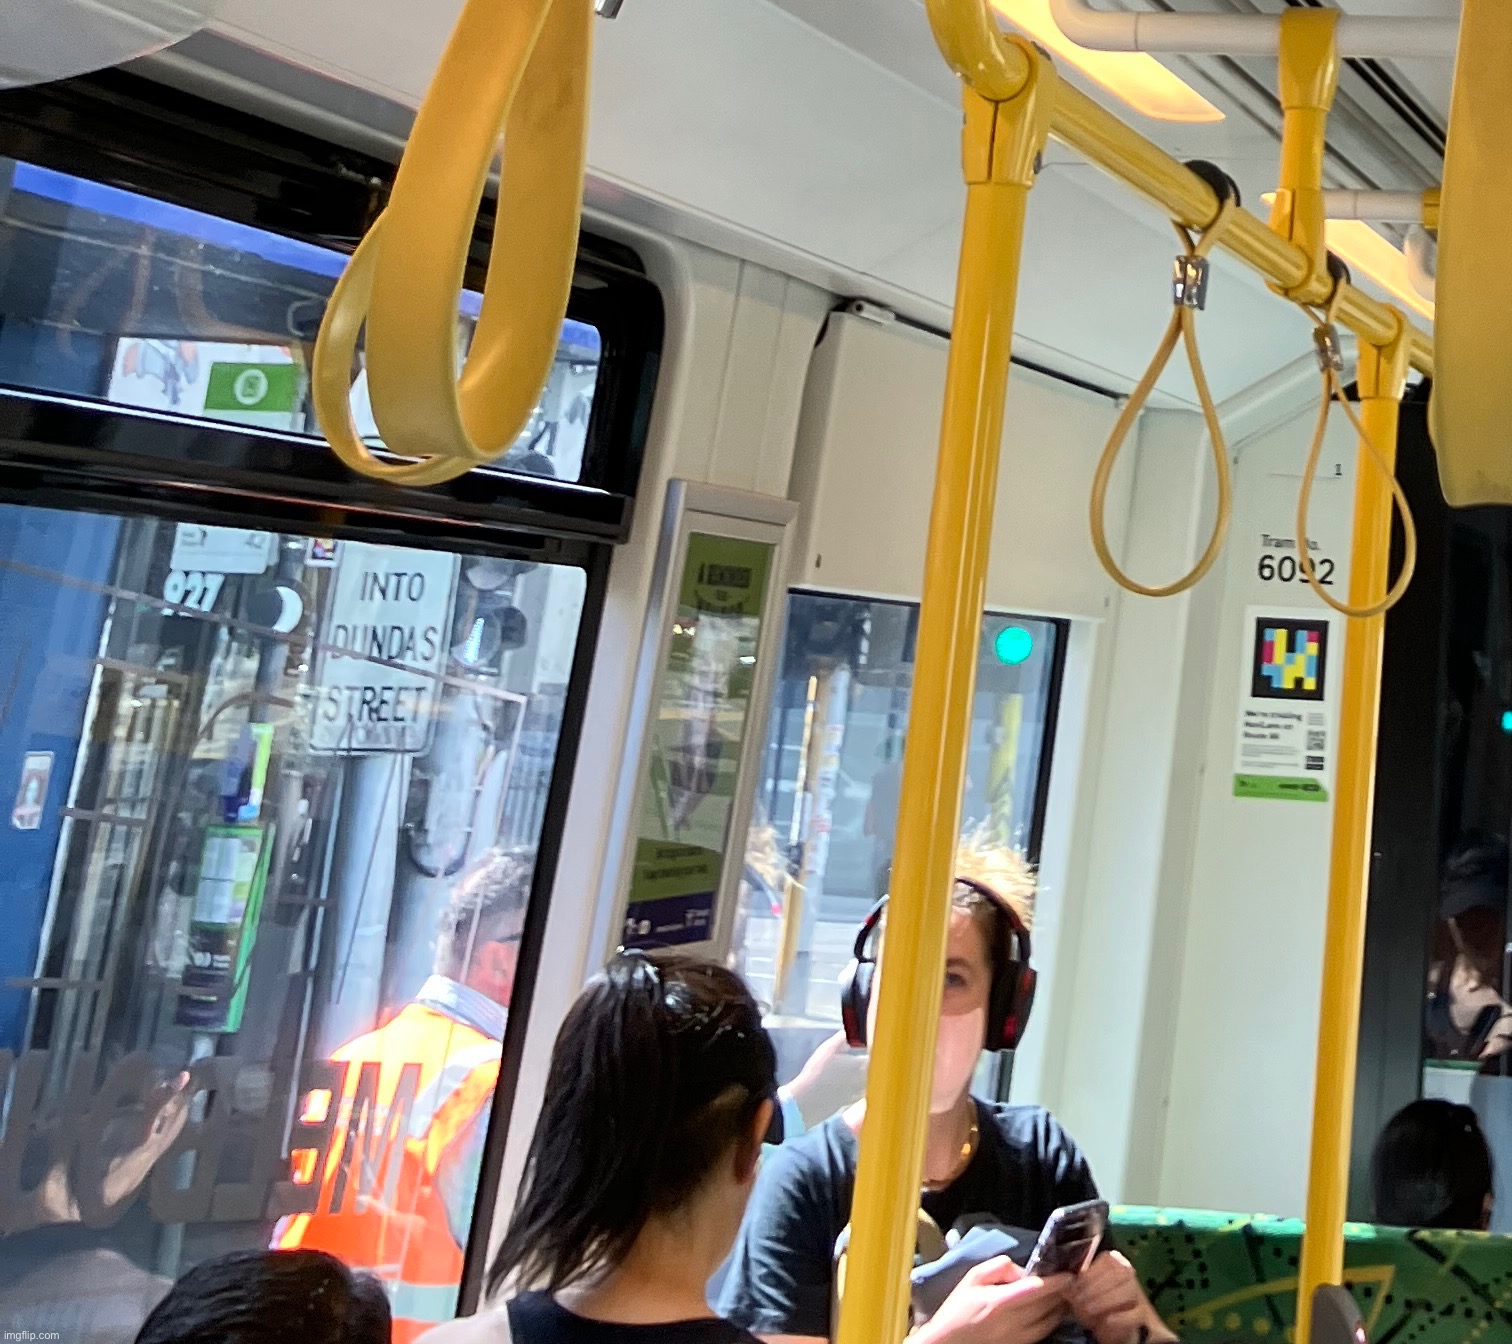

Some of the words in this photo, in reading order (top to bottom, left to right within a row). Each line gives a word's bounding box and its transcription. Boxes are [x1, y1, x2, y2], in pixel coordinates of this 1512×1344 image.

[360, 570, 426, 602] INTO
[1258, 553, 1335, 585] 6092
[332, 623, 440, 662] DUNDAS
[322, 685, 427, 723] STREET
